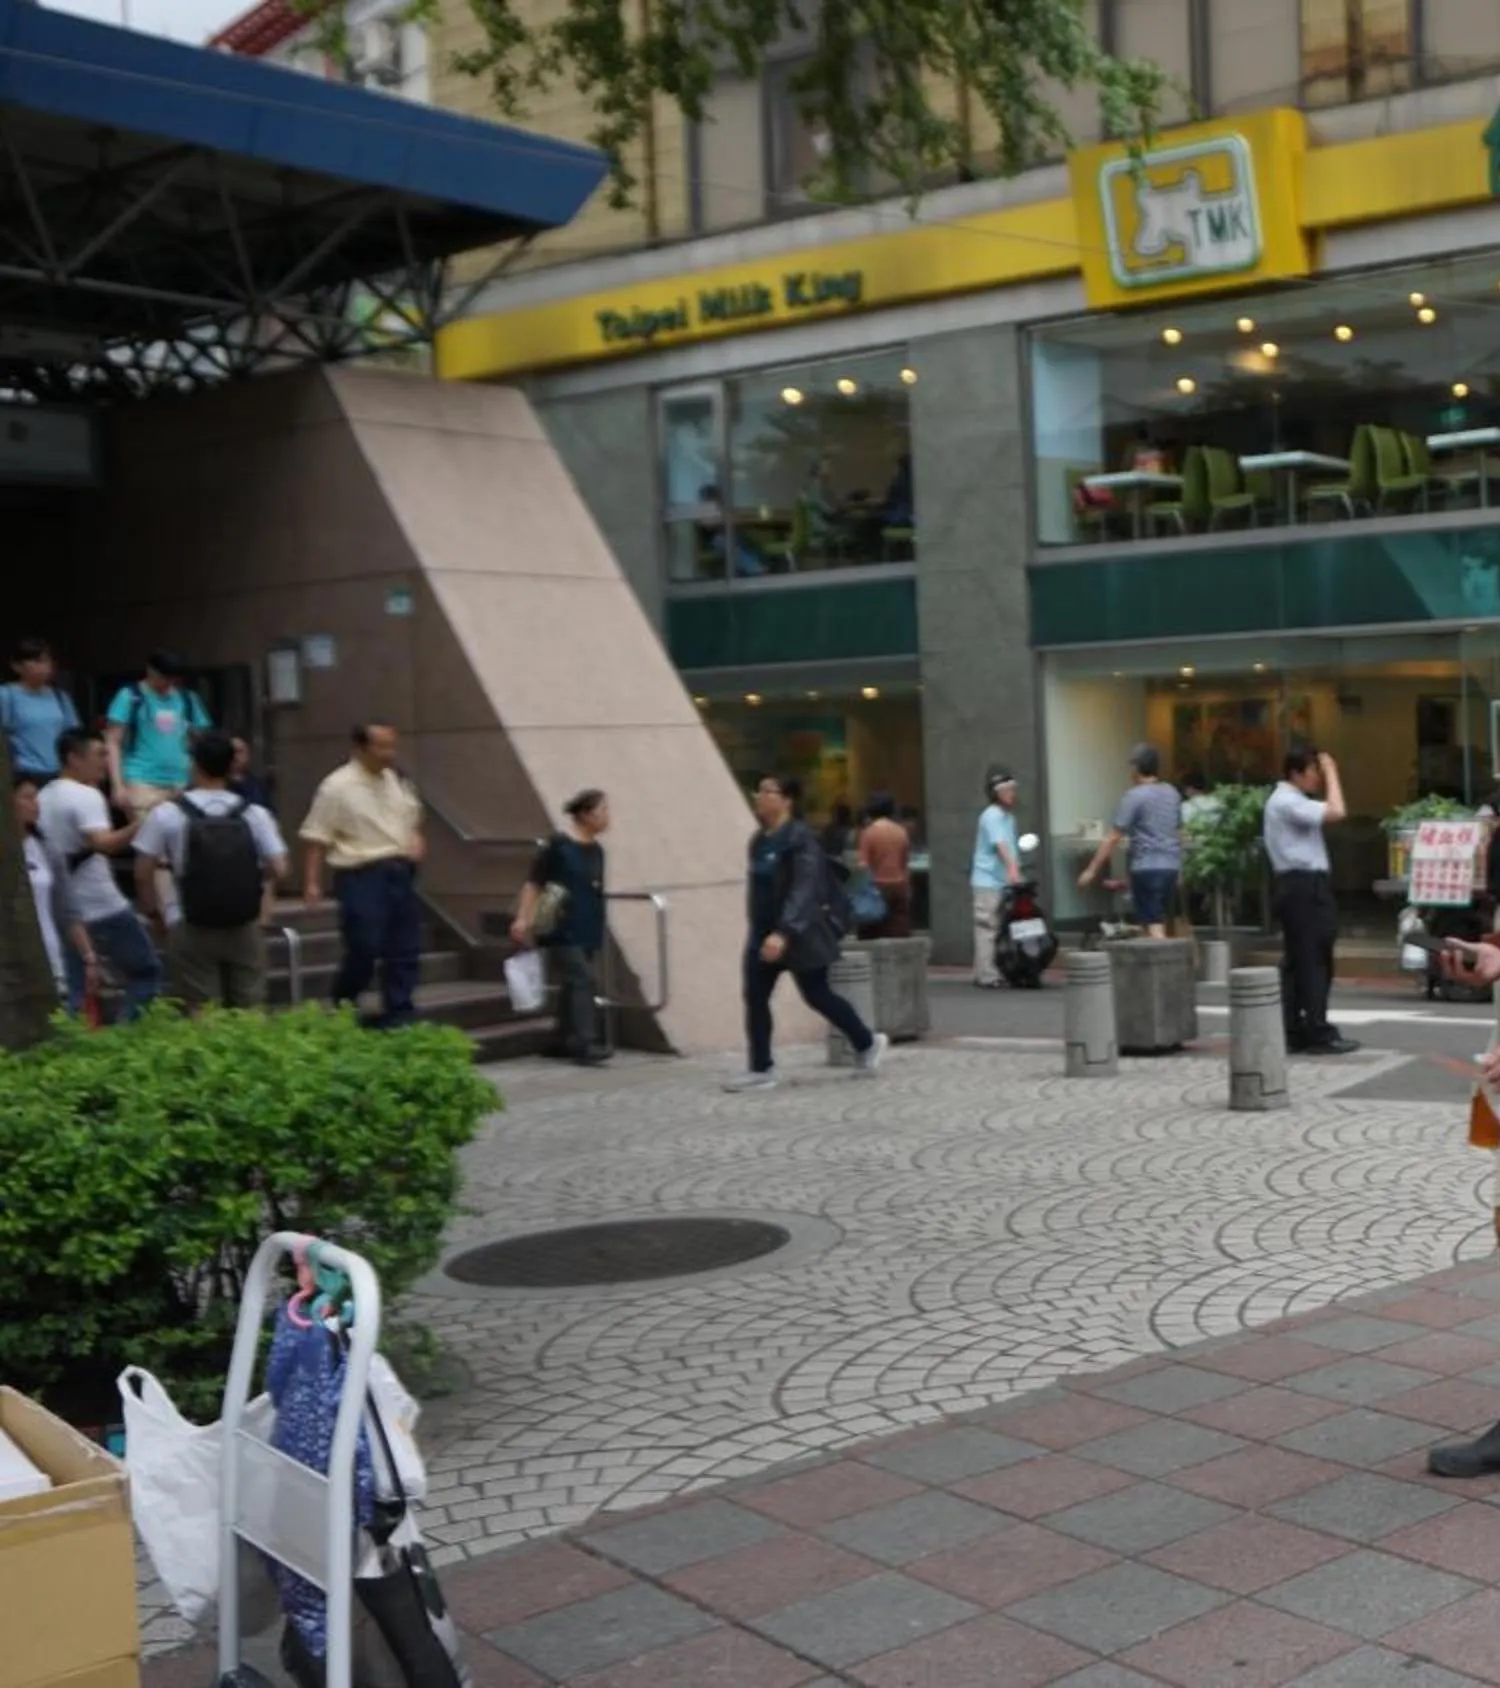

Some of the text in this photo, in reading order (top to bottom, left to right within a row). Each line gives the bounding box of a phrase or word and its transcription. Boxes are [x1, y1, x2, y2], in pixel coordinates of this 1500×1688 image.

[1187, 203, 1249, 248] TMK
[595, 269, 862, 345] Taipei Milk King
